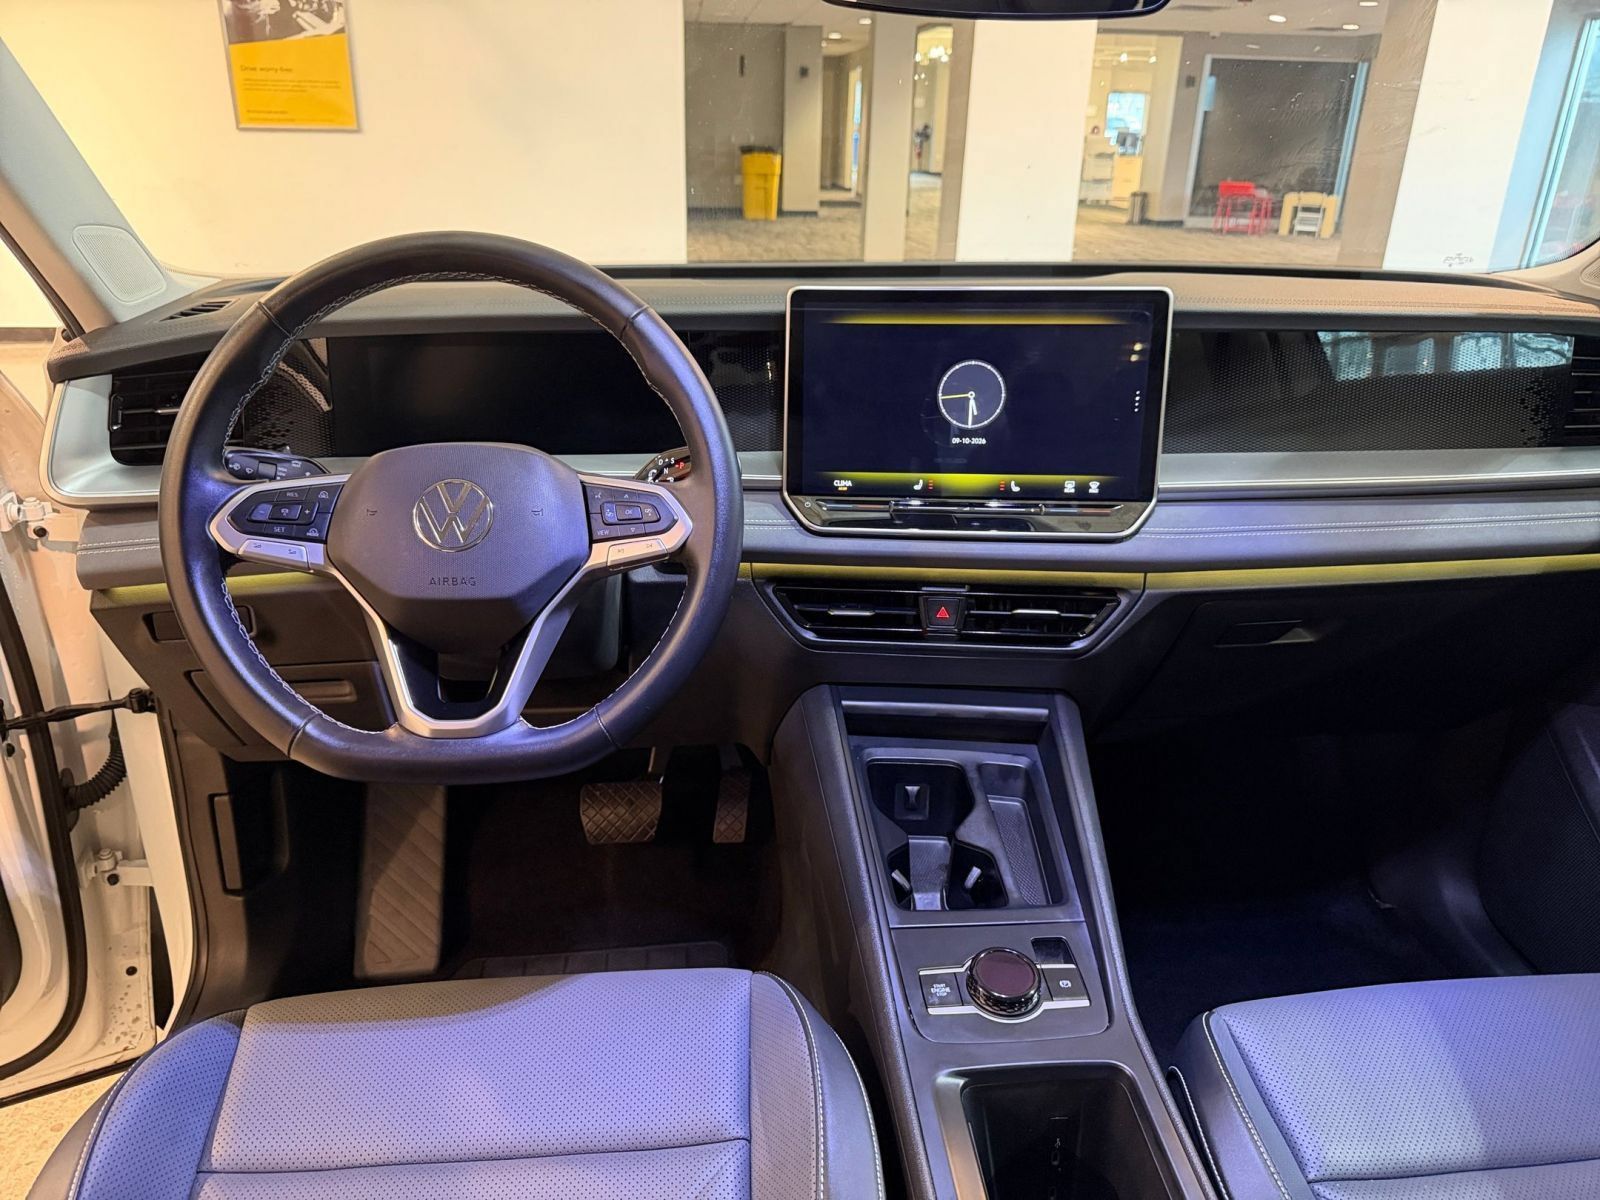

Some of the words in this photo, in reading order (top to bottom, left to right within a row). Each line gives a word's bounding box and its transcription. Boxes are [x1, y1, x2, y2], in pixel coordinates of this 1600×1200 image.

[663, 467, 669, 475] N
[833, 479, 853, 487] CLIMA
[428, 576, 477, 587] AIRBAG
